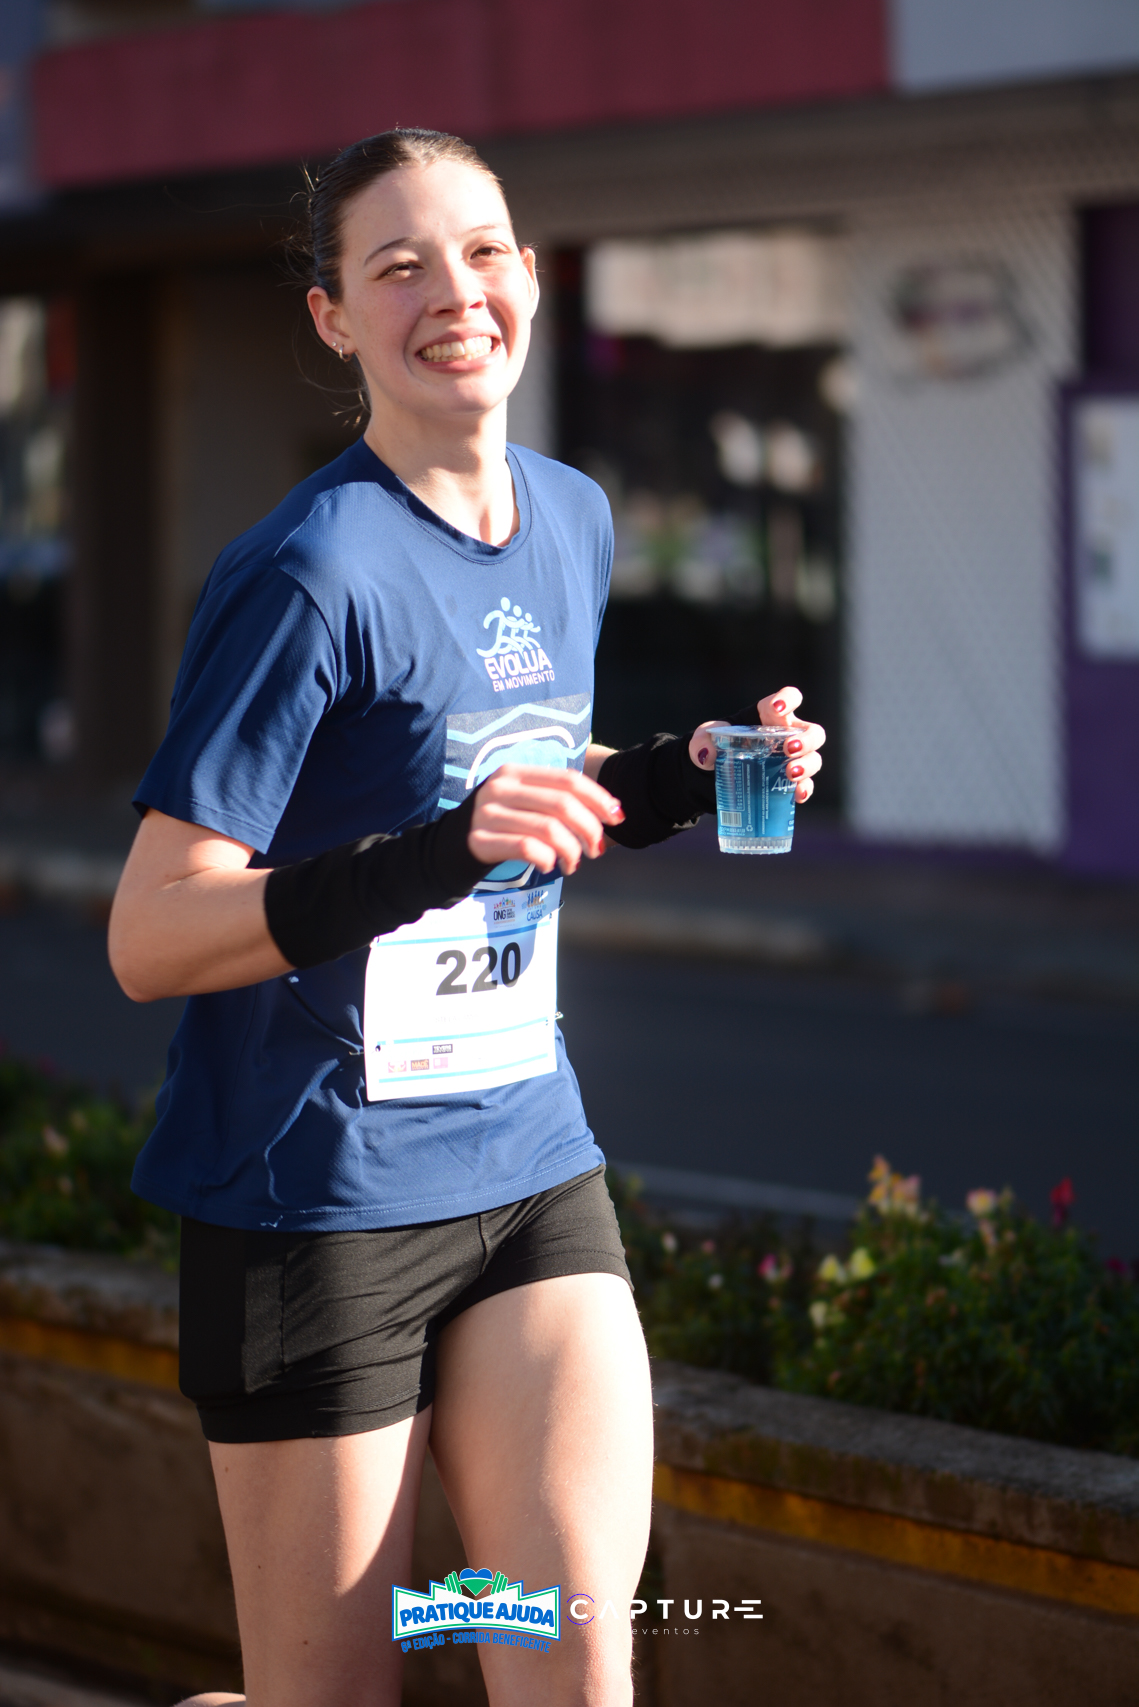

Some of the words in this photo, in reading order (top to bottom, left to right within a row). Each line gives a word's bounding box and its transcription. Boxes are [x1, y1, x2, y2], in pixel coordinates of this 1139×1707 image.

[484, 648, 552, 679] EVOLUA
[492, 680, 505, 692] EM
[504, 669, 555, 690] MOVIMENTO
[493, 909, 507, 921] ONG
[526, 908, 543, 922] CAUSA
[436, 942, 521, 995] 220
